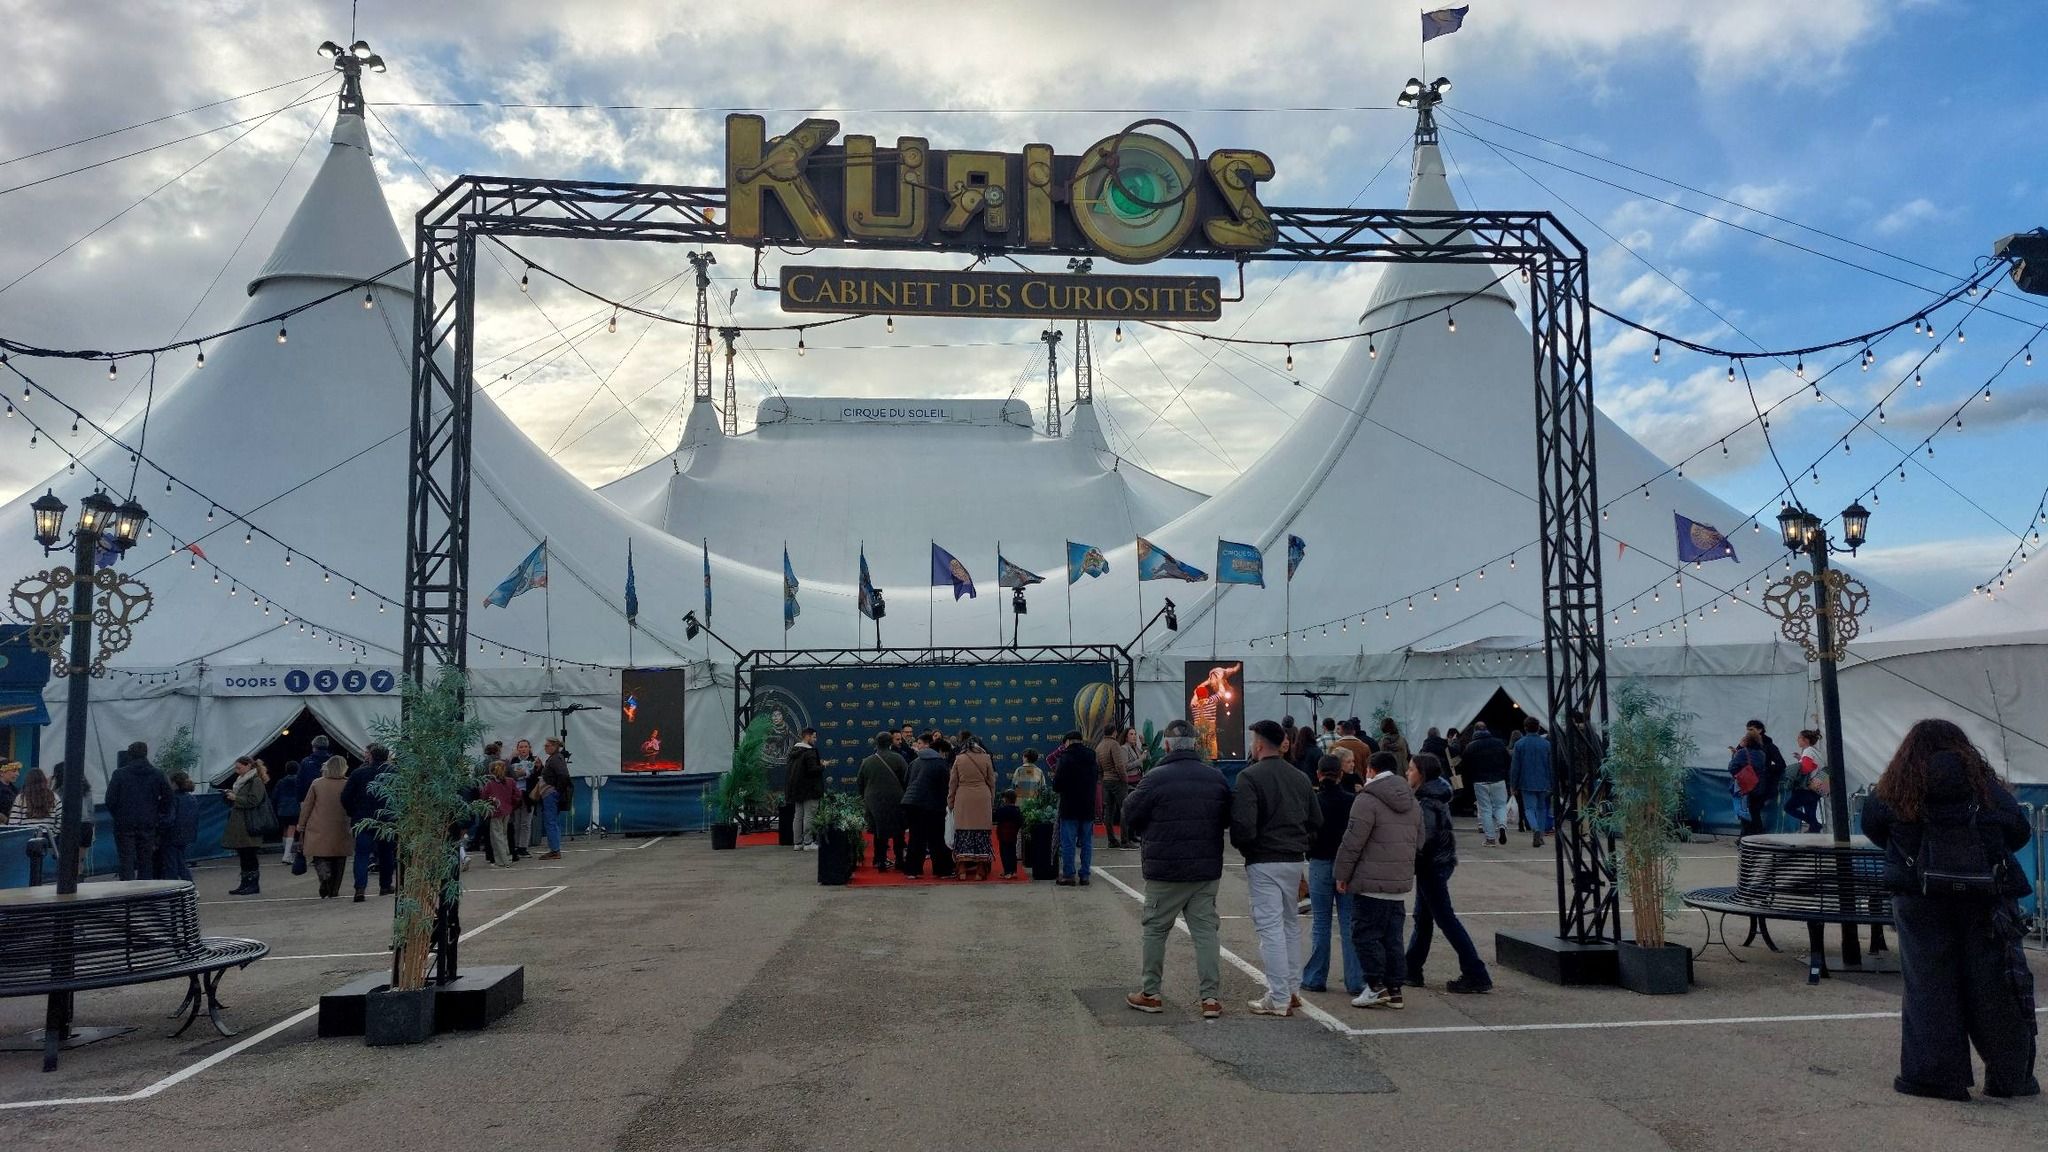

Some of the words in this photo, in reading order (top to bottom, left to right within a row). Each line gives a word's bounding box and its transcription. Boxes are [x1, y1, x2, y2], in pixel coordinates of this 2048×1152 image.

[787, 275, 940, 306] CABINET
[950, 282, 1011, 309] DES
[1021, 281, 1217, 313] CURIOSITÉS
[843, 408, 887, 421] CIRQUE
[889, 408, 906, 418] DU
[908, 409, 948, 418] SOLEIL
[225, 677, 277, 688] DOORS
[293, 675, 301, 687] 1
[320, 675, 332, 687] 3
[349, 675, 361, 687] 5
[376, 675, 389, 687] 7
